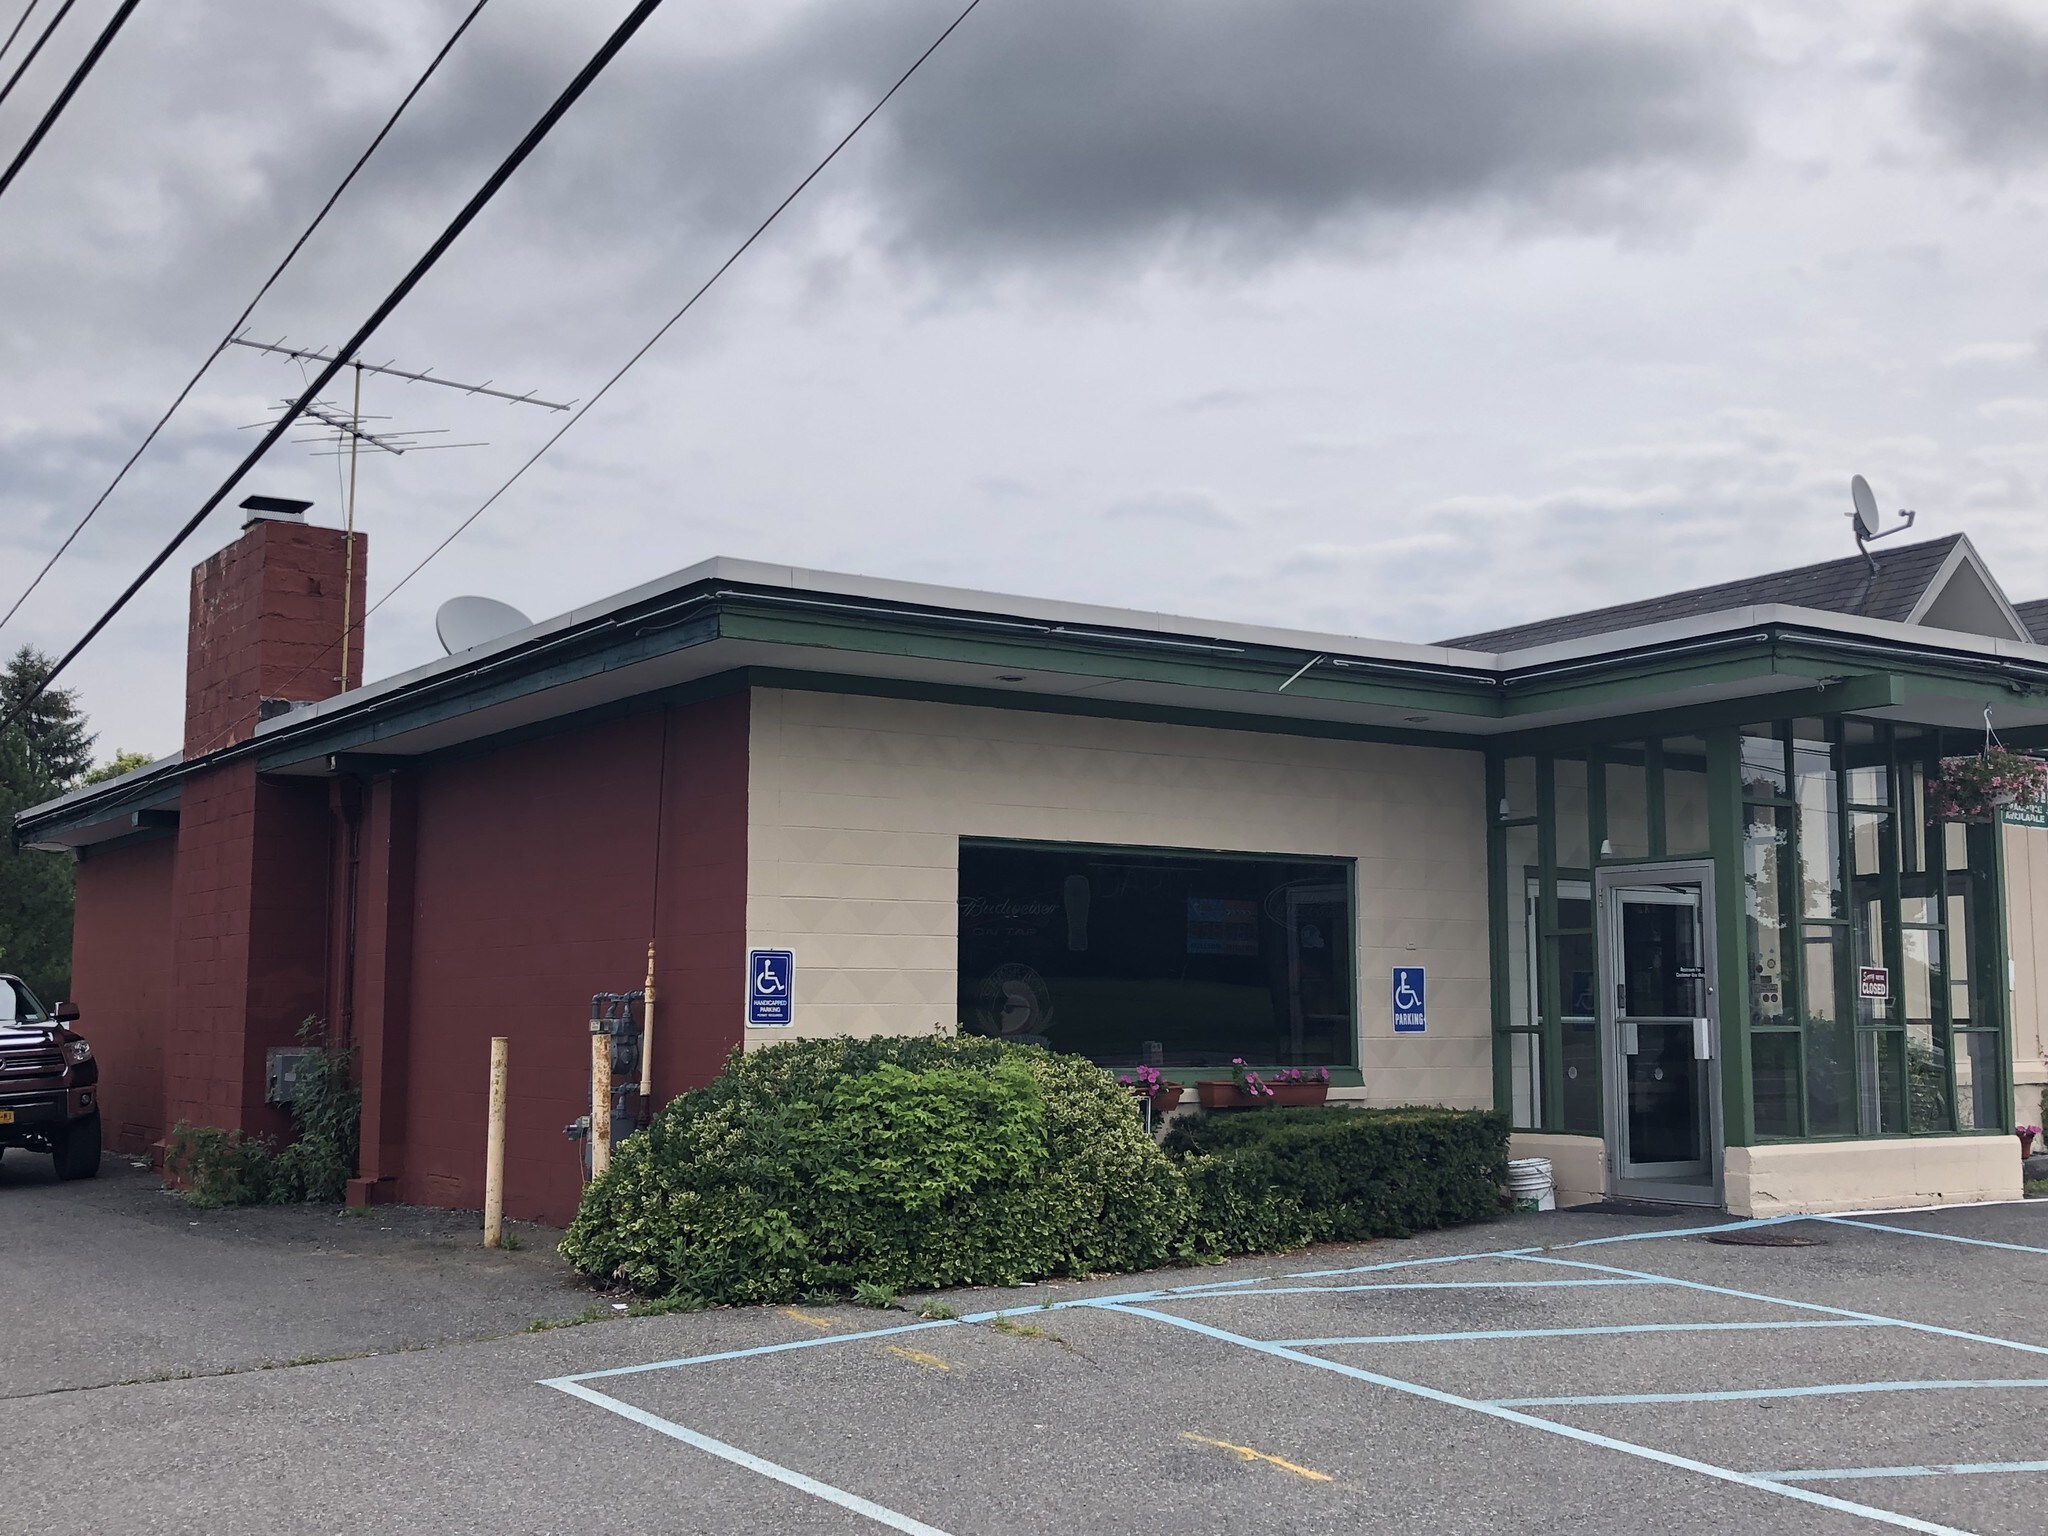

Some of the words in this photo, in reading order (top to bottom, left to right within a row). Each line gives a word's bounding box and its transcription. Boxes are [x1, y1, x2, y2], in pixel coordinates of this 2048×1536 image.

[960, 896, 1057, 917] Budweiser
[1862, 982, 1886, 995] CLOSED
[1395, 1012, 1424, 1026] PARKING
